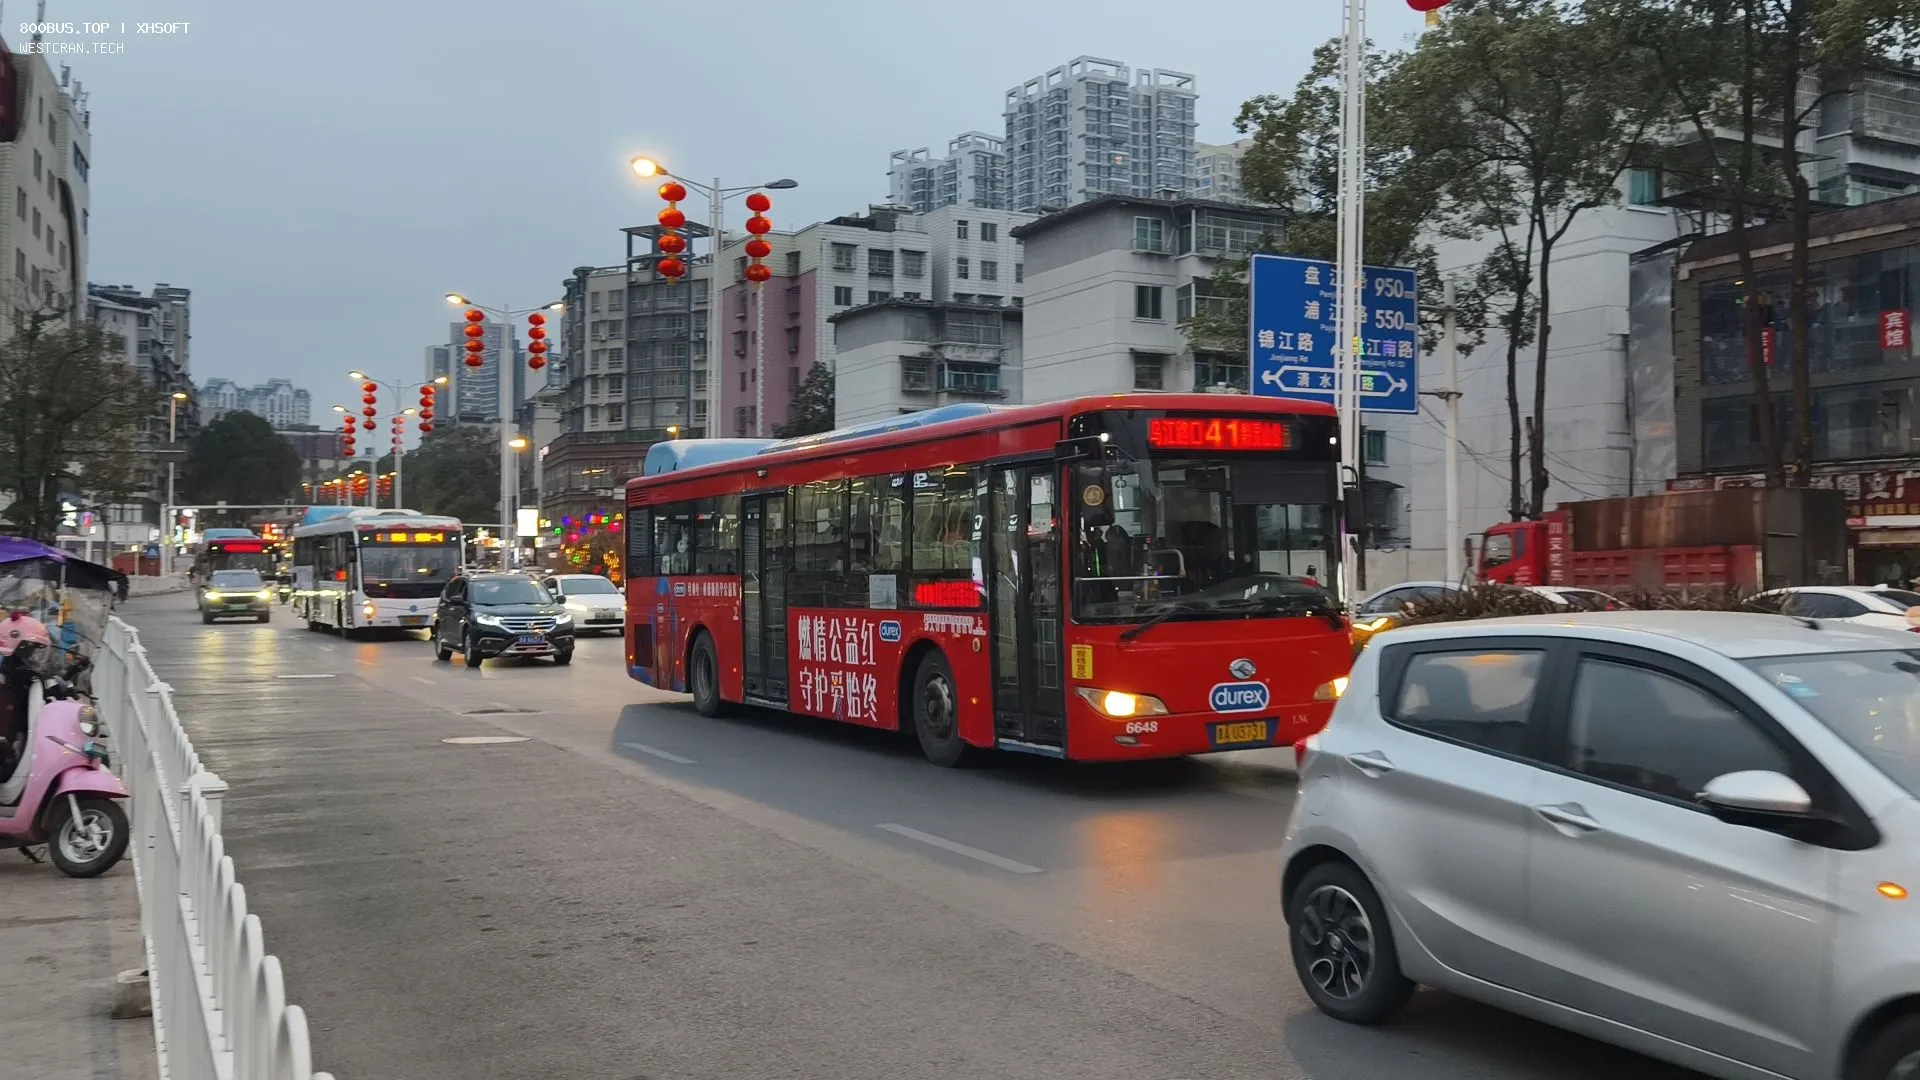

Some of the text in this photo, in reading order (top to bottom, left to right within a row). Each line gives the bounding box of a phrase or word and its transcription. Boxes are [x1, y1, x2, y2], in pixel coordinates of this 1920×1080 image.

[1258, 328, 1314, 352] 锦江路
[1884, 311, 1905, 347] 宾馆
[1297, 372, 1375, 391] 清水路
[1205, 418, 1239, 447] 41
[798, 615, 877, 666] 燃情公益红
[880, 624, 900, 638] durex
[1214, 687, 1266, 708] durex
[1125, 720, 1158, 734] 6648
